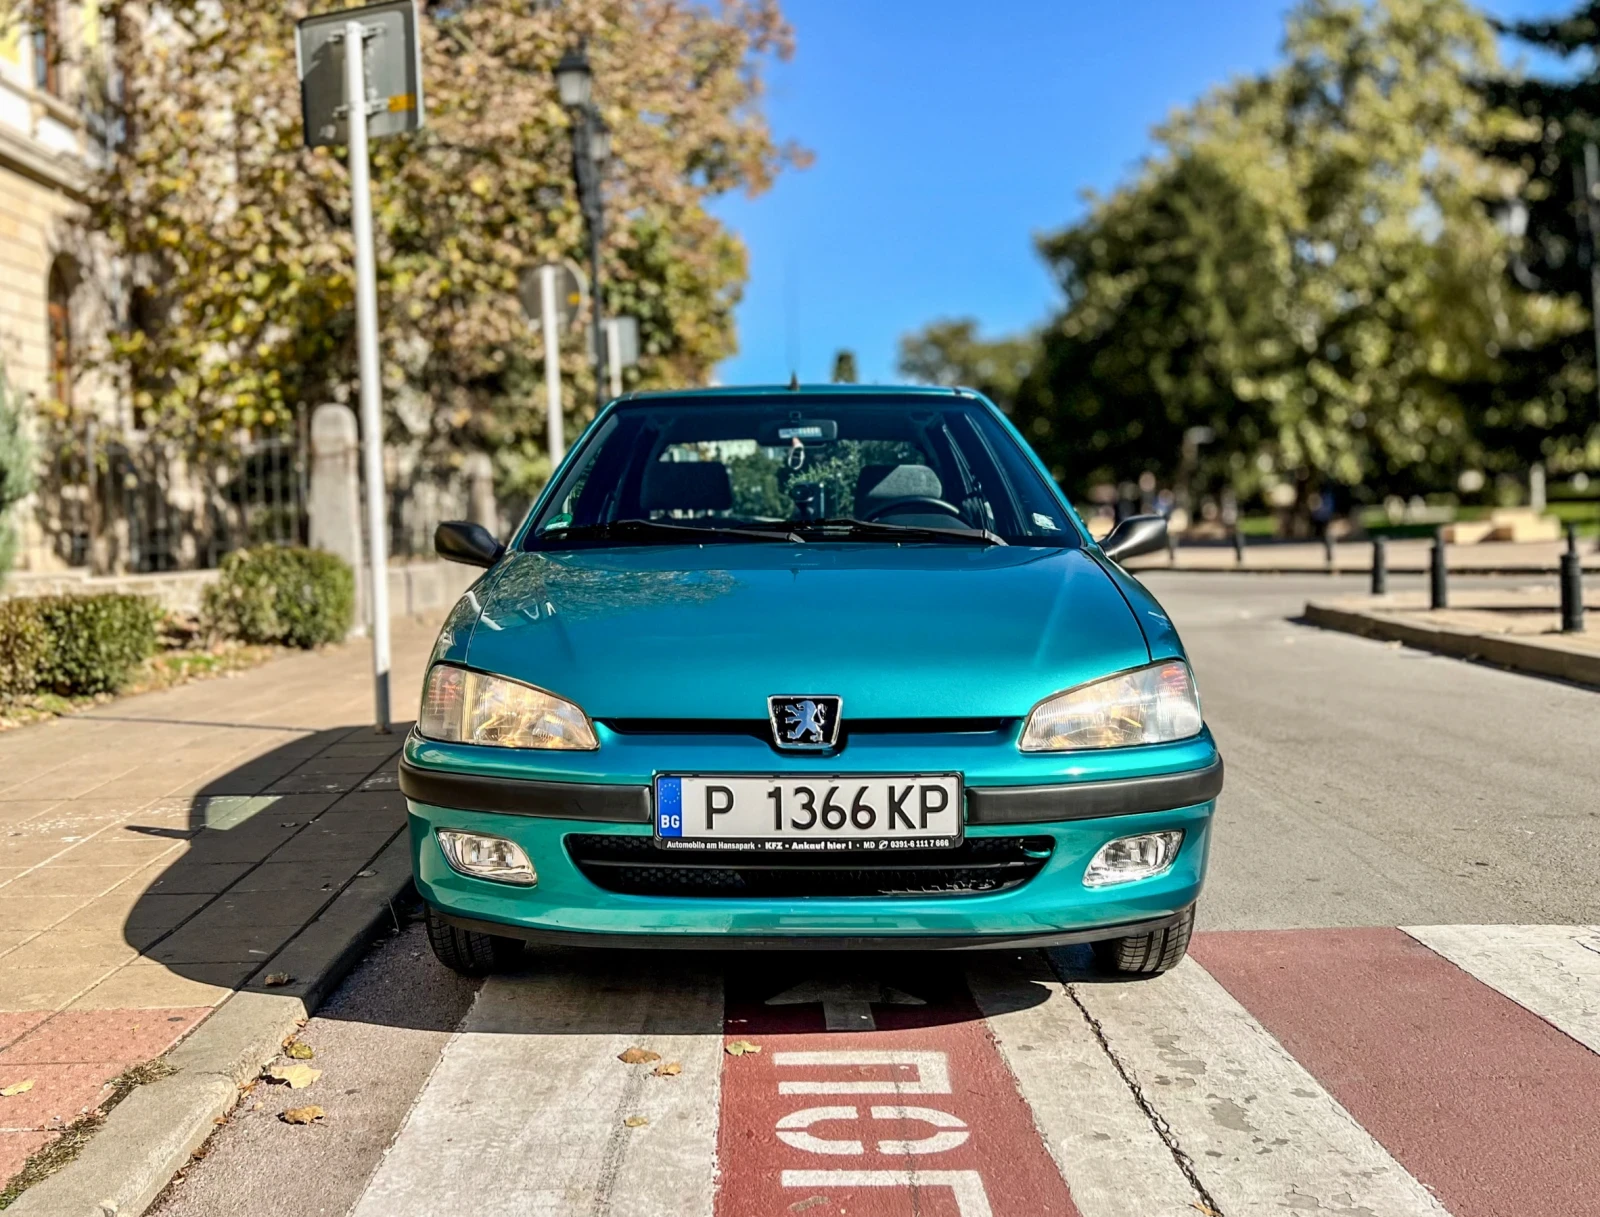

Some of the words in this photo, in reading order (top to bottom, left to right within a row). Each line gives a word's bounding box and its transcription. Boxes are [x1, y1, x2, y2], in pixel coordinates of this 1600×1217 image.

[705, 785, 735, 830] P
[766, 784, 877, 831] 1366
[888, 784, 949, 830] KP
[660, 814, 680, 828] BG
[666, 841, 705, 849] Automobile
[718, 841, 755, 851] Hansapark
[765, 841, 783, 850] KFZ
[791, 841, 825, 850] Ankauf
[826, 841, 846, 850] hier
